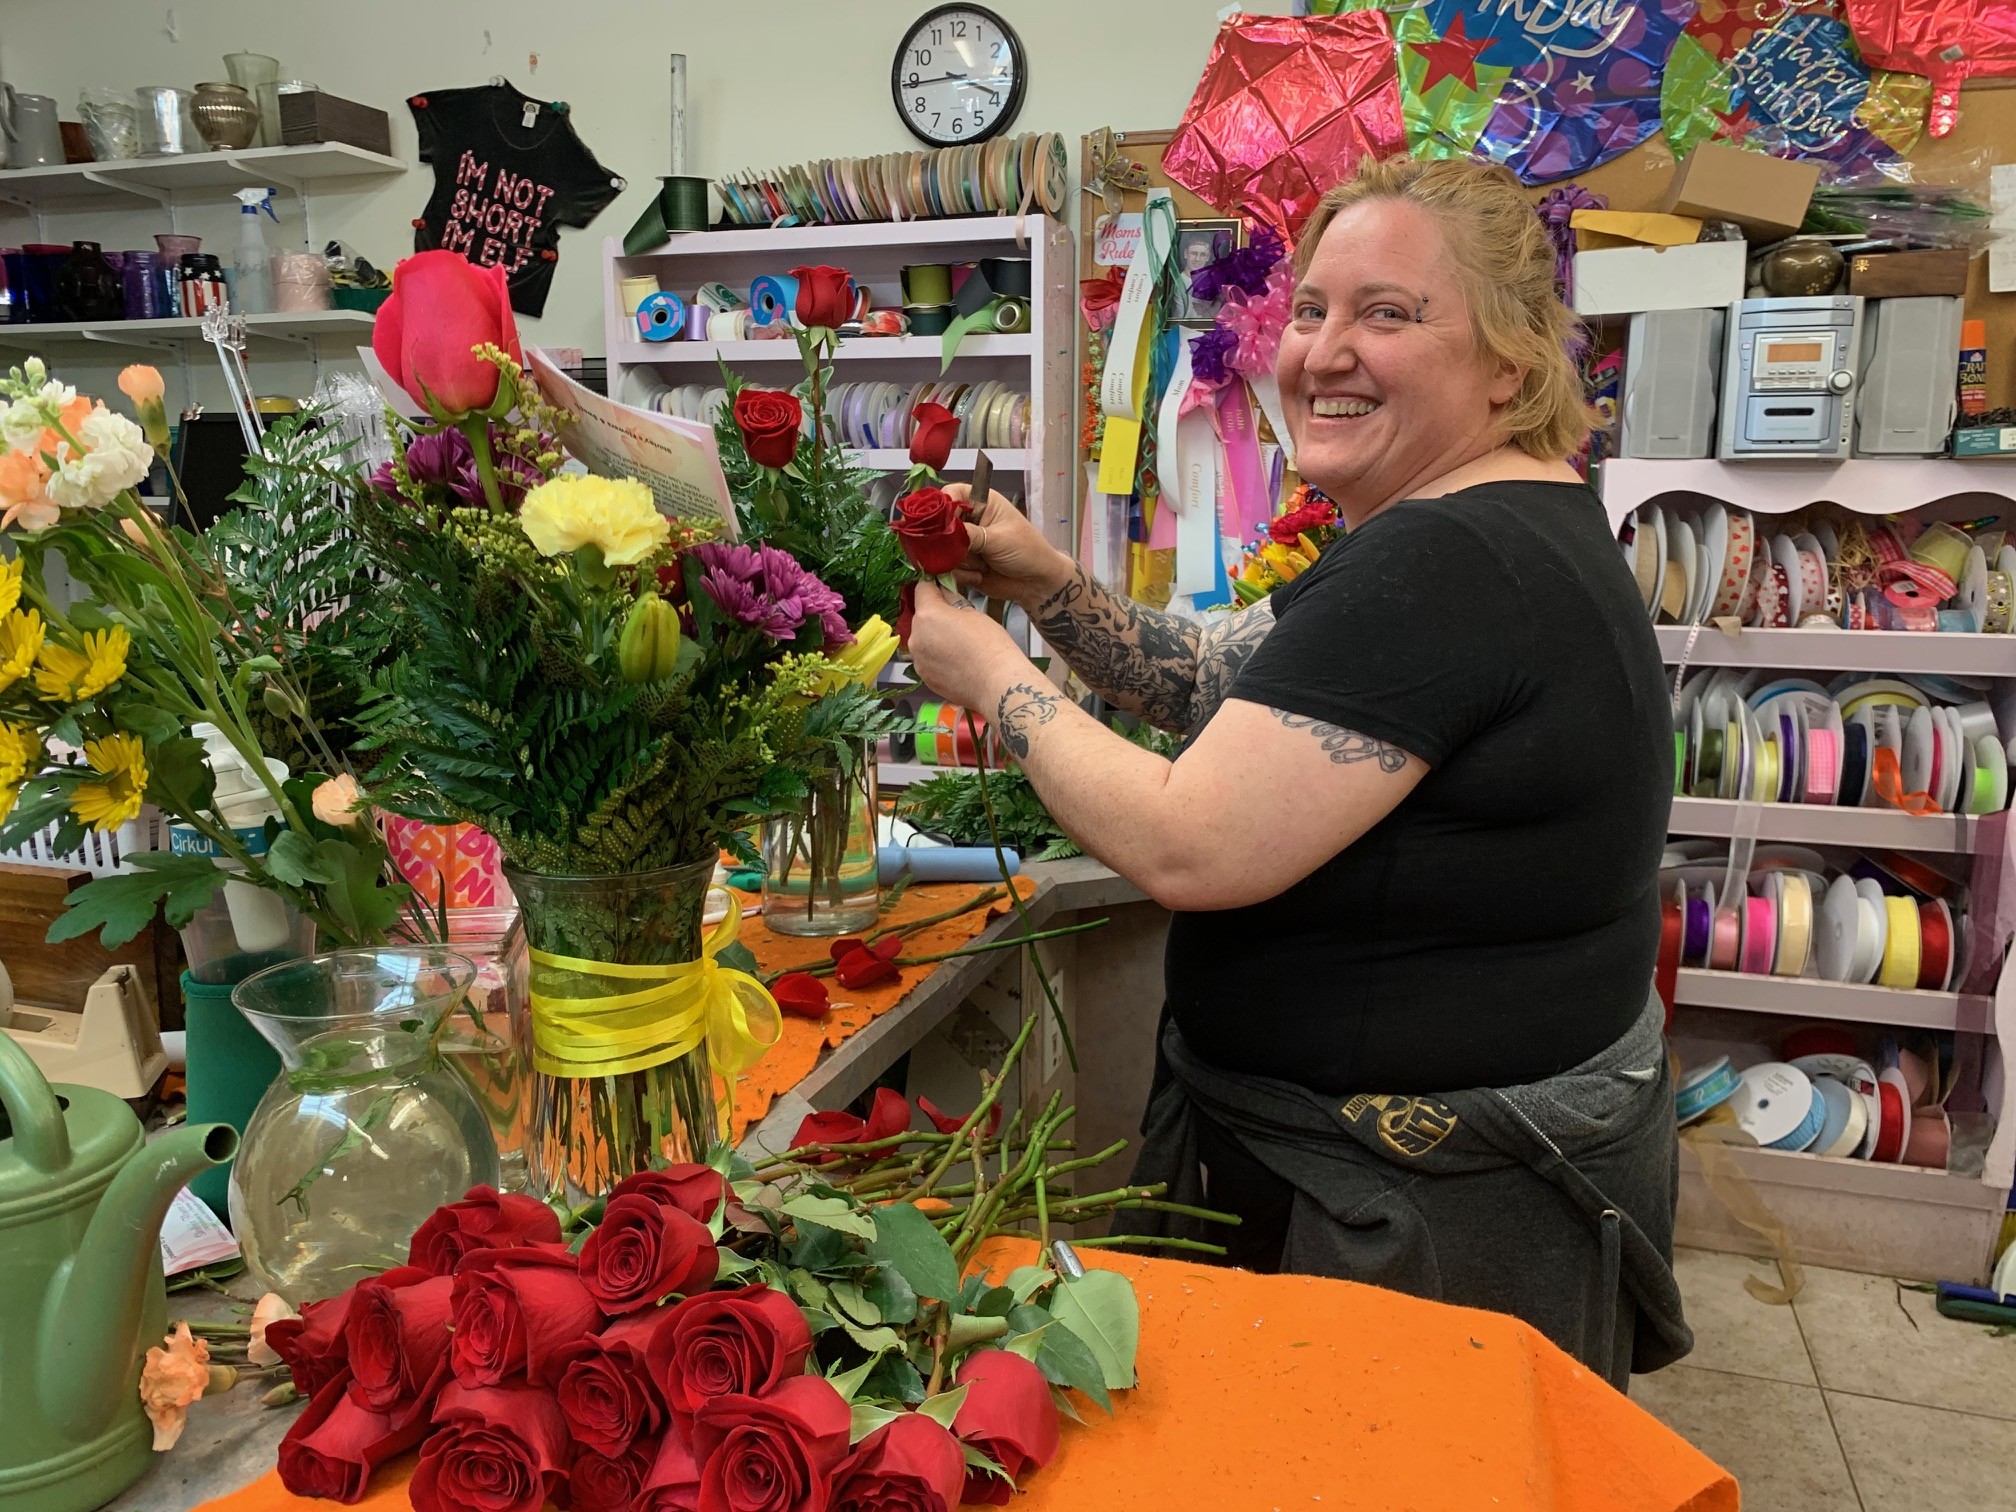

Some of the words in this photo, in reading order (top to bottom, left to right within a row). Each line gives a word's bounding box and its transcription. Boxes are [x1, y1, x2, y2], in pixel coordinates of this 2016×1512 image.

[931, 29, 942, 46] 11
[950, 20, 966, 38] 12
[976, 25, 981, 42] 1
[914, 49, 931, 66] 10
[990, 42, 1001, 59] 2
[1752, 6, 1871, 111] Happy
[908, 72, 919, 89] 9
[915, 97, 926, 113] 8
[988, 91, 1001, 107] 4
[931, 112, 941, 128] 7
[952, 118, 963, 134] 6
[973, 110, 984, 126] 5
[493, 168, 555, 217] NOT
[451, 188, 542, 248] SHORT
[1101, 223, 1142, 240] Moms
[480, 237, 534, 274] ELF
[1100, 240, 1135, 260] Rule
[1128, 273, 1139, 304] Comfort
[1136, 273, 1148, 303] Comfort
[1109, 372, 1117, 405] Comfort
[1189, 463, 1203, 509] Comfort
[171, 833, 214, 854] Cirkul
